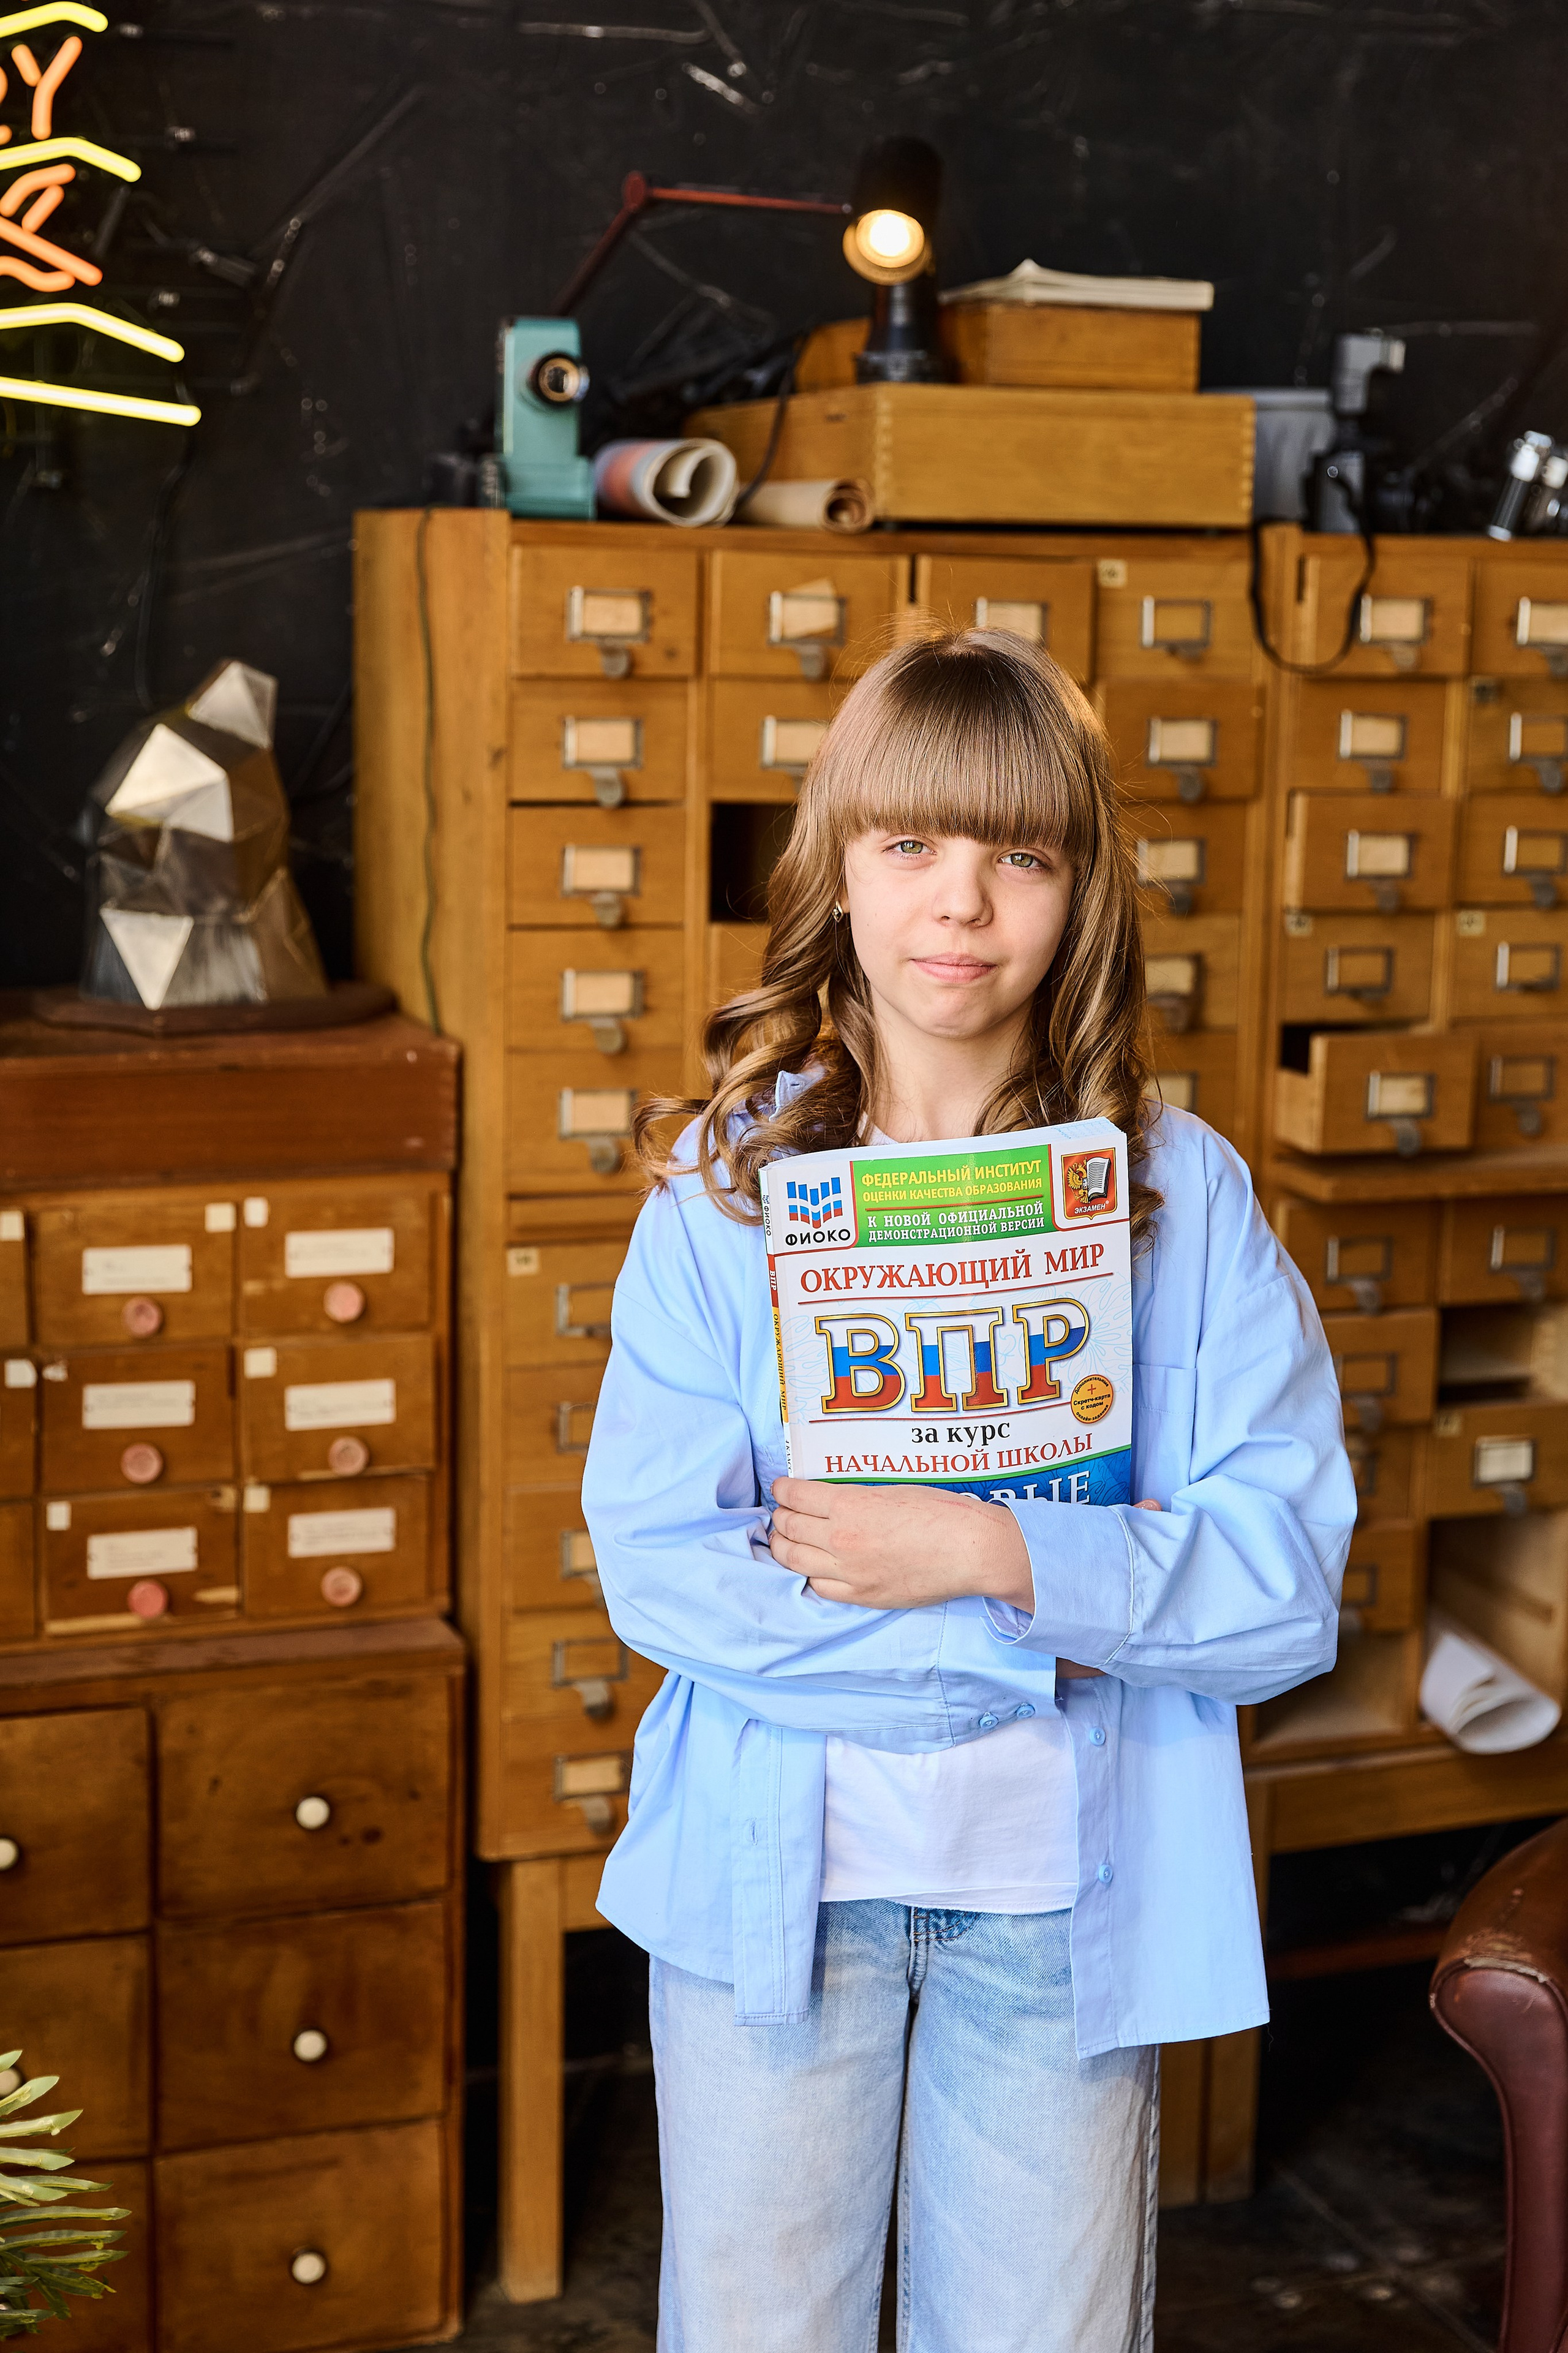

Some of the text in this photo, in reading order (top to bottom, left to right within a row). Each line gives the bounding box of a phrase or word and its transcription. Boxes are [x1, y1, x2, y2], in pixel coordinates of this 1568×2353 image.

[862, 1160, 1042, 1188] ФЕДЕРАЛЬНЫЙ ИНСТИТУТ
[863, 1178, 1042, 1203] ОЦЕНКИ КАЧЕСТВА ОБРАЗОВАНИЯ
[867, 1201, 1044, 1228] К НОВОЙ ОФИЦИАЛЬНОЙ
[1074, 1203, 1106, 1214] ЭКЗАМЕН
[785, 1229, 851, 1246] ФИОКО
[869, 1217, 1044, 1242] ДЕМОНСТРАЦИОННОЙ ВЕРСИИ
[801, 1243, 1104, 1293] ОКРУЖАЮЩИЙ МИР
[773, 1313, 786, 1385] ОКРУЖАЮЩИЙ
[815, 1297, 1090, 1413] ВПР
[911, 1422, 1010, 1448] за курс
[824, 1433, 1093, 1473] НАЧАЛЬНОЙ ШКОЛЫ
